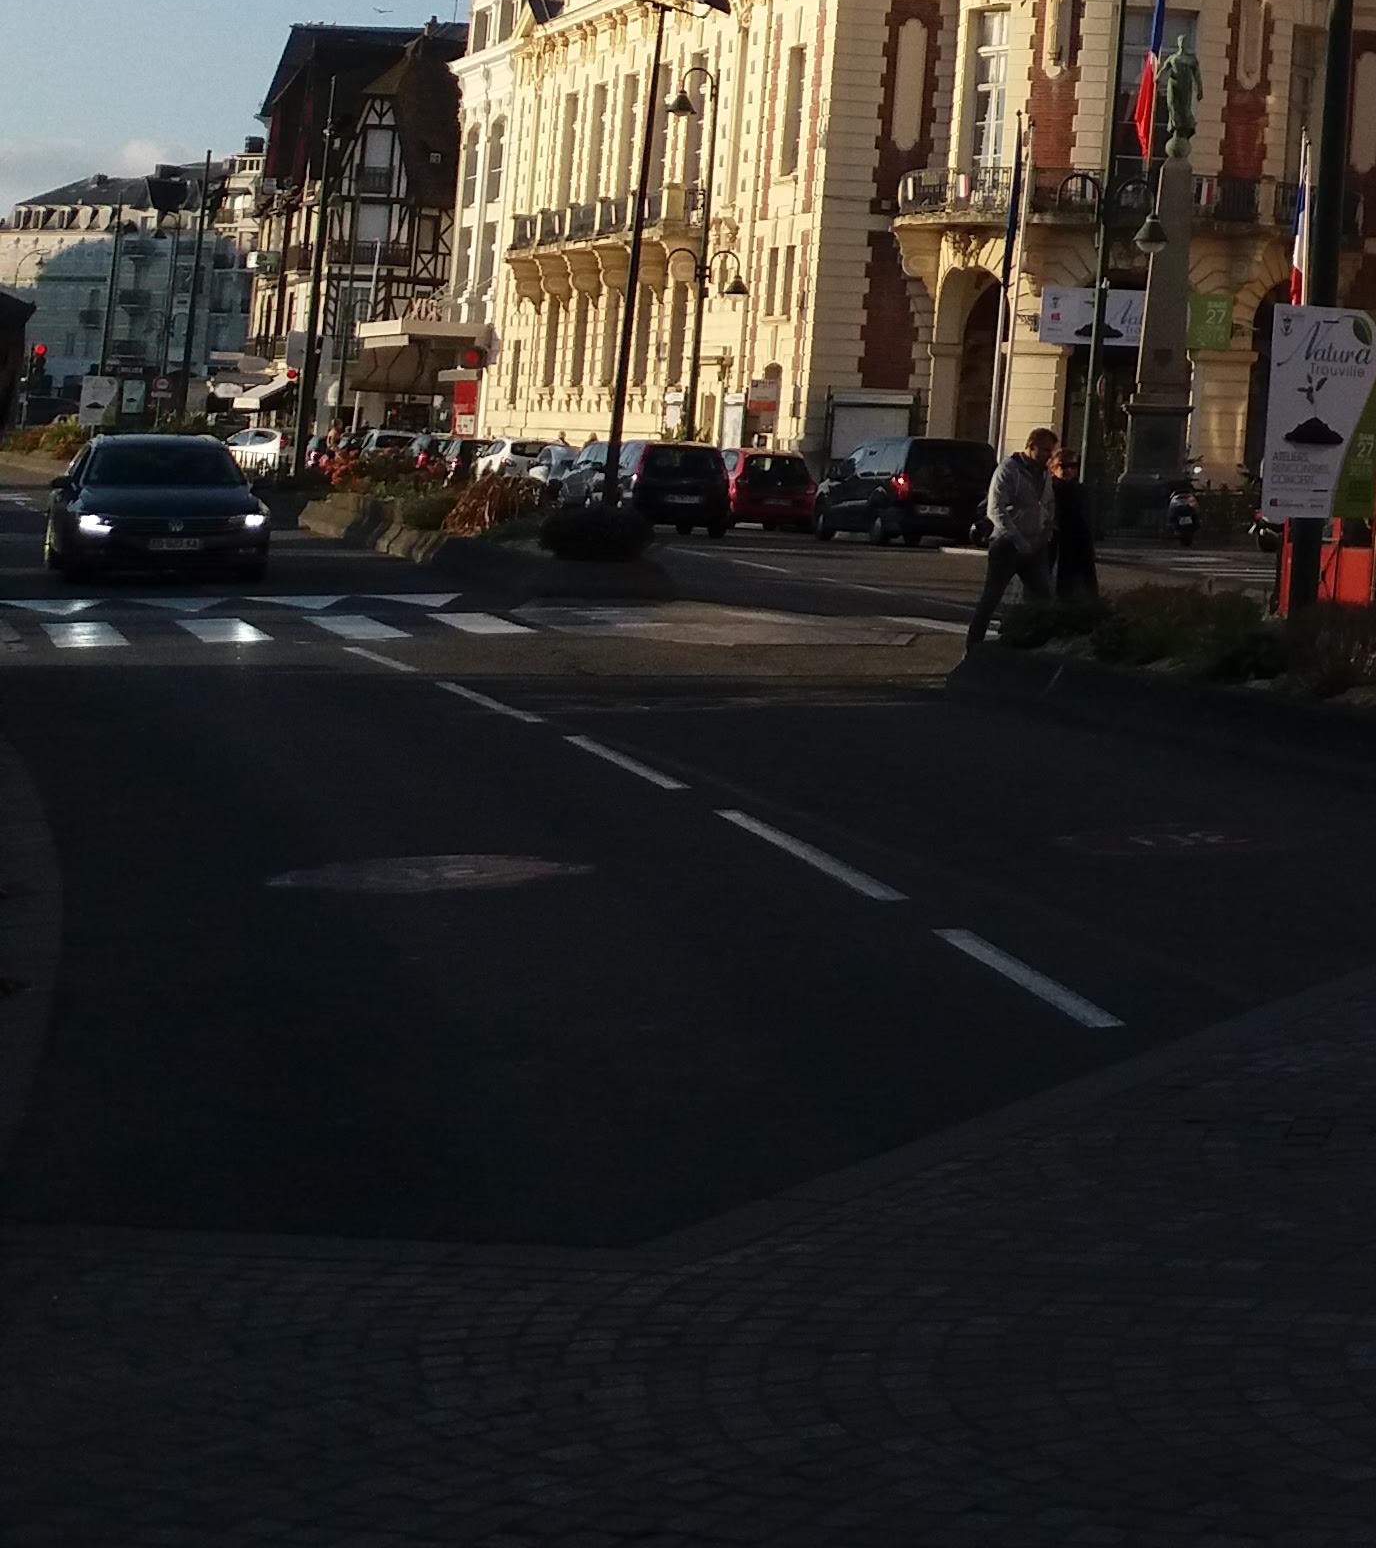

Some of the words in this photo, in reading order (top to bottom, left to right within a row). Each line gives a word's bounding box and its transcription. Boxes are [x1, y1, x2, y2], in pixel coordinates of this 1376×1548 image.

[1205, 308, 1226, 324] 27
[1277, 319, 1374, 366] Natura
[1310, 363, 1365, 378] Trouville
[1357, 442, 1374, 457] 27
